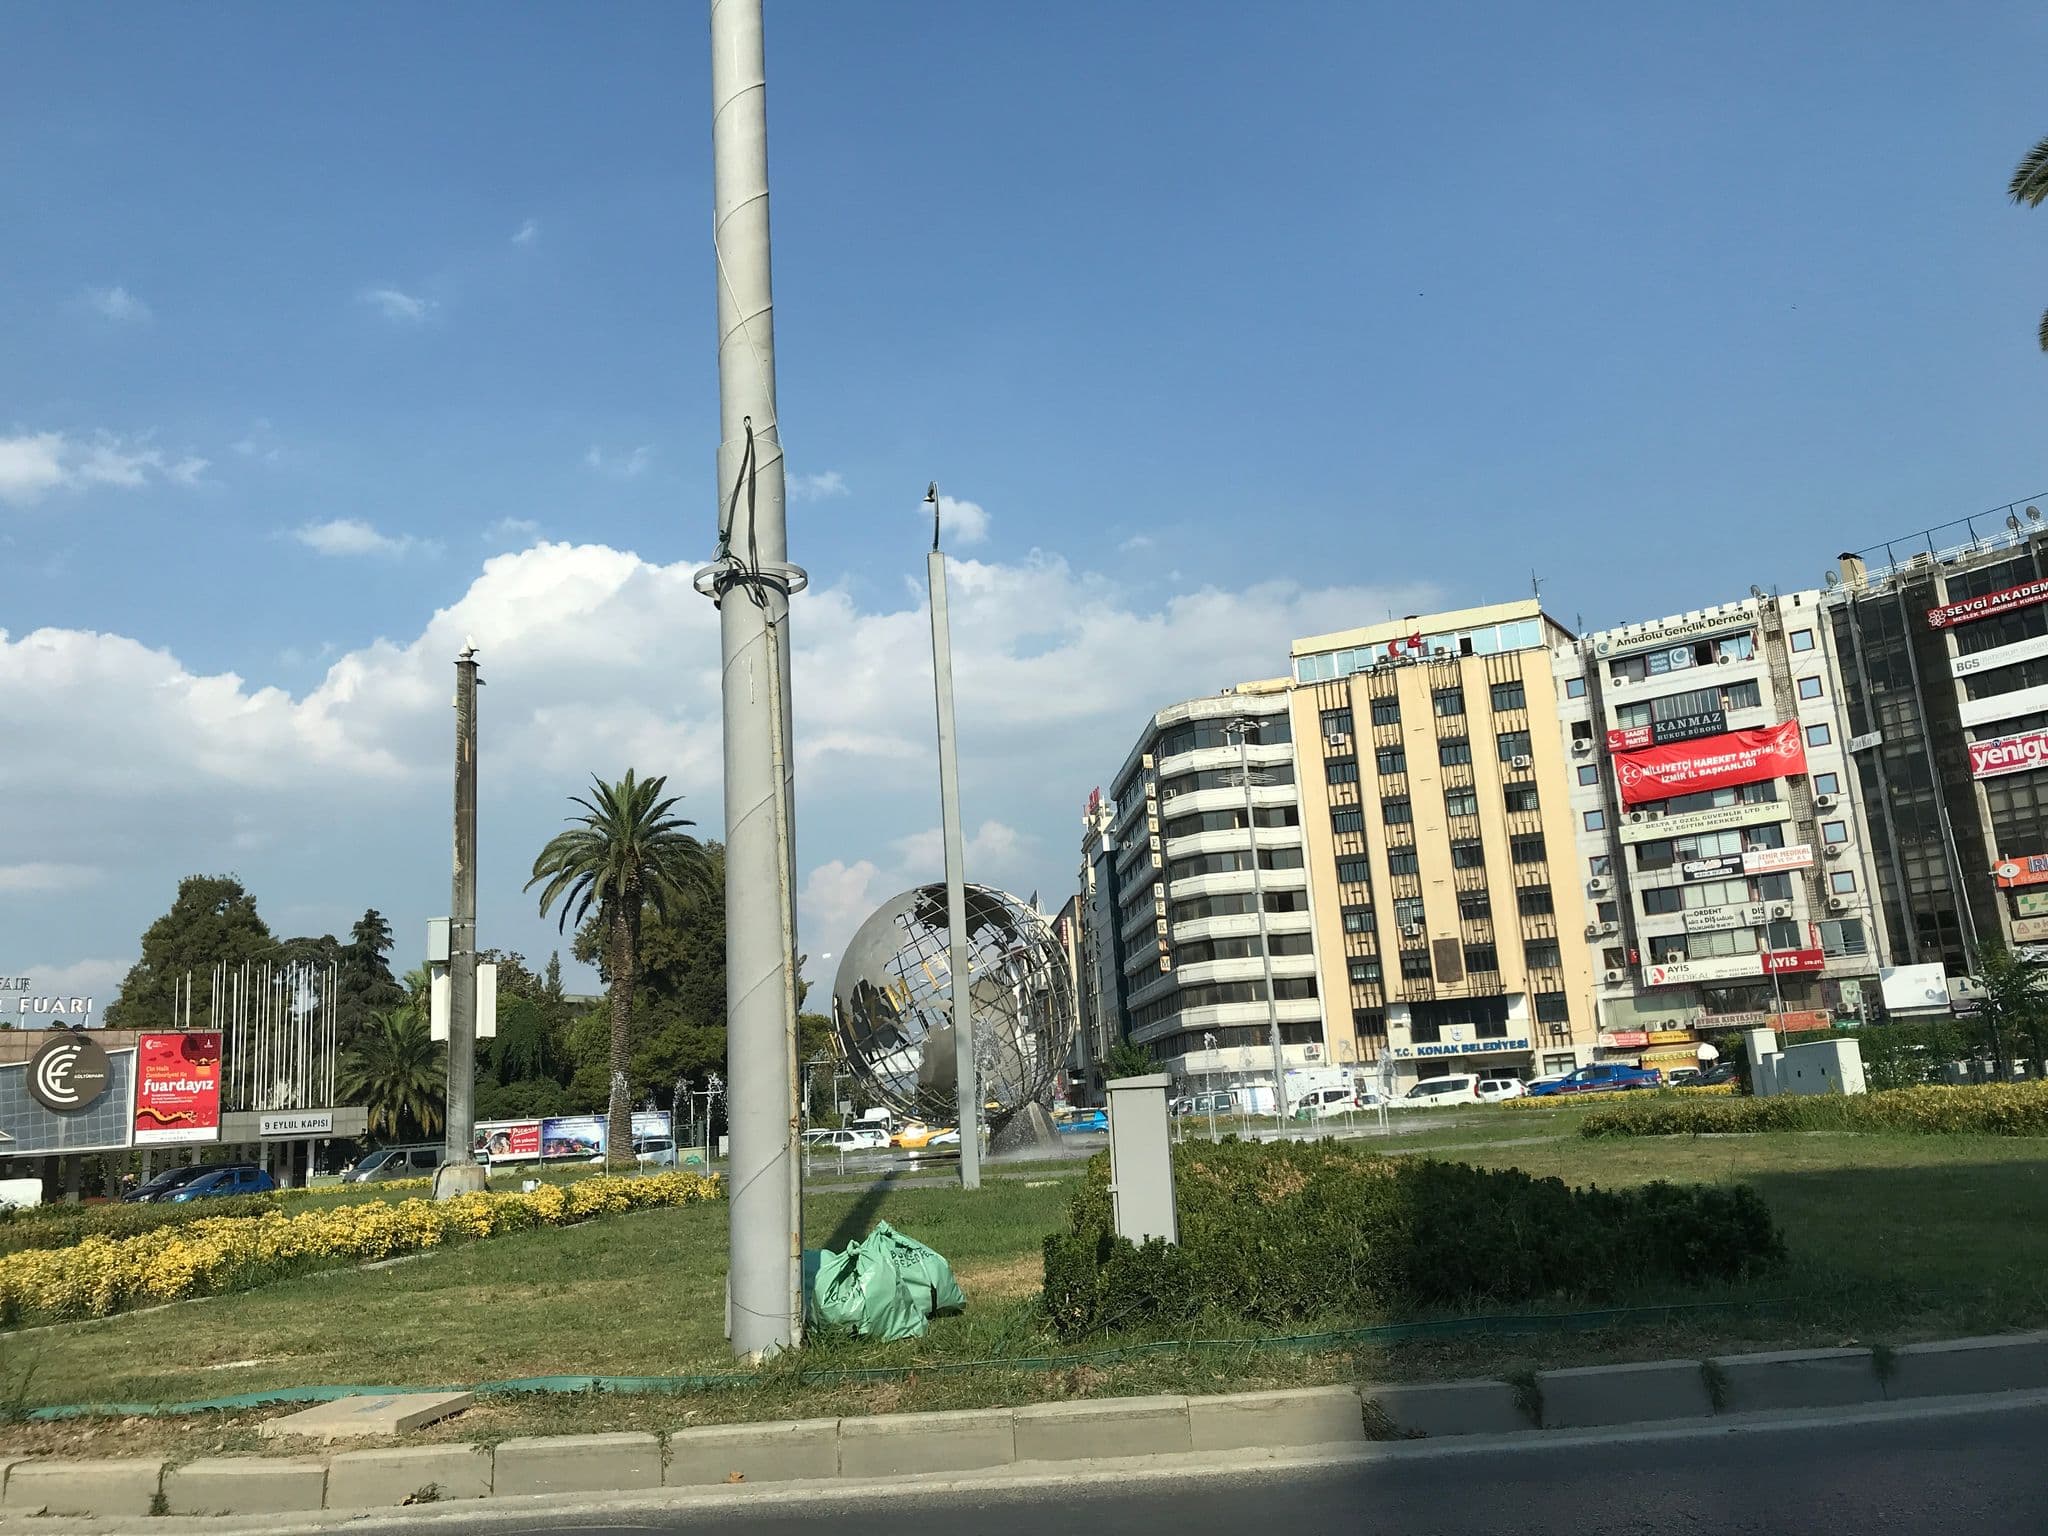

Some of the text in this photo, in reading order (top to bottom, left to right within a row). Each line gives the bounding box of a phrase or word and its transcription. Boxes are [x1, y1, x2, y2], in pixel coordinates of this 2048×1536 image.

[1947, 597, 1988, 617] SEVGİ
[1617, 632, 1663, 648] Anadolu
[1665, 621, 1706, 638] Gençlik
[1708, 610, 1754, 629] Derneği
[1956, 658, 1980, 672] BGS
[1656, 712, 1721, 733] KANMAZ
[1658, 729, 1687, 741] HUKUK
[1642, 758, 1692, 777] MİLLİYETÇİ
[1693, 755, 1737, 768] HAREKET
[1661, 772, 1687, 784] İZMİR
[1700, 758, 1756, 778] BAŞKANLIĞI
[1667, 964, 1690, 973] AYİS
[1768, 956, 1798, 969] AYİS
[19, 997, 92, 1015] FUARI
[1395, 1038, 1529, 1057] T.C. KONAK BELEDİYESİ
[143, 1078, 214, 1095] fuardayız
[264, 1121, 270, 1130] 9
